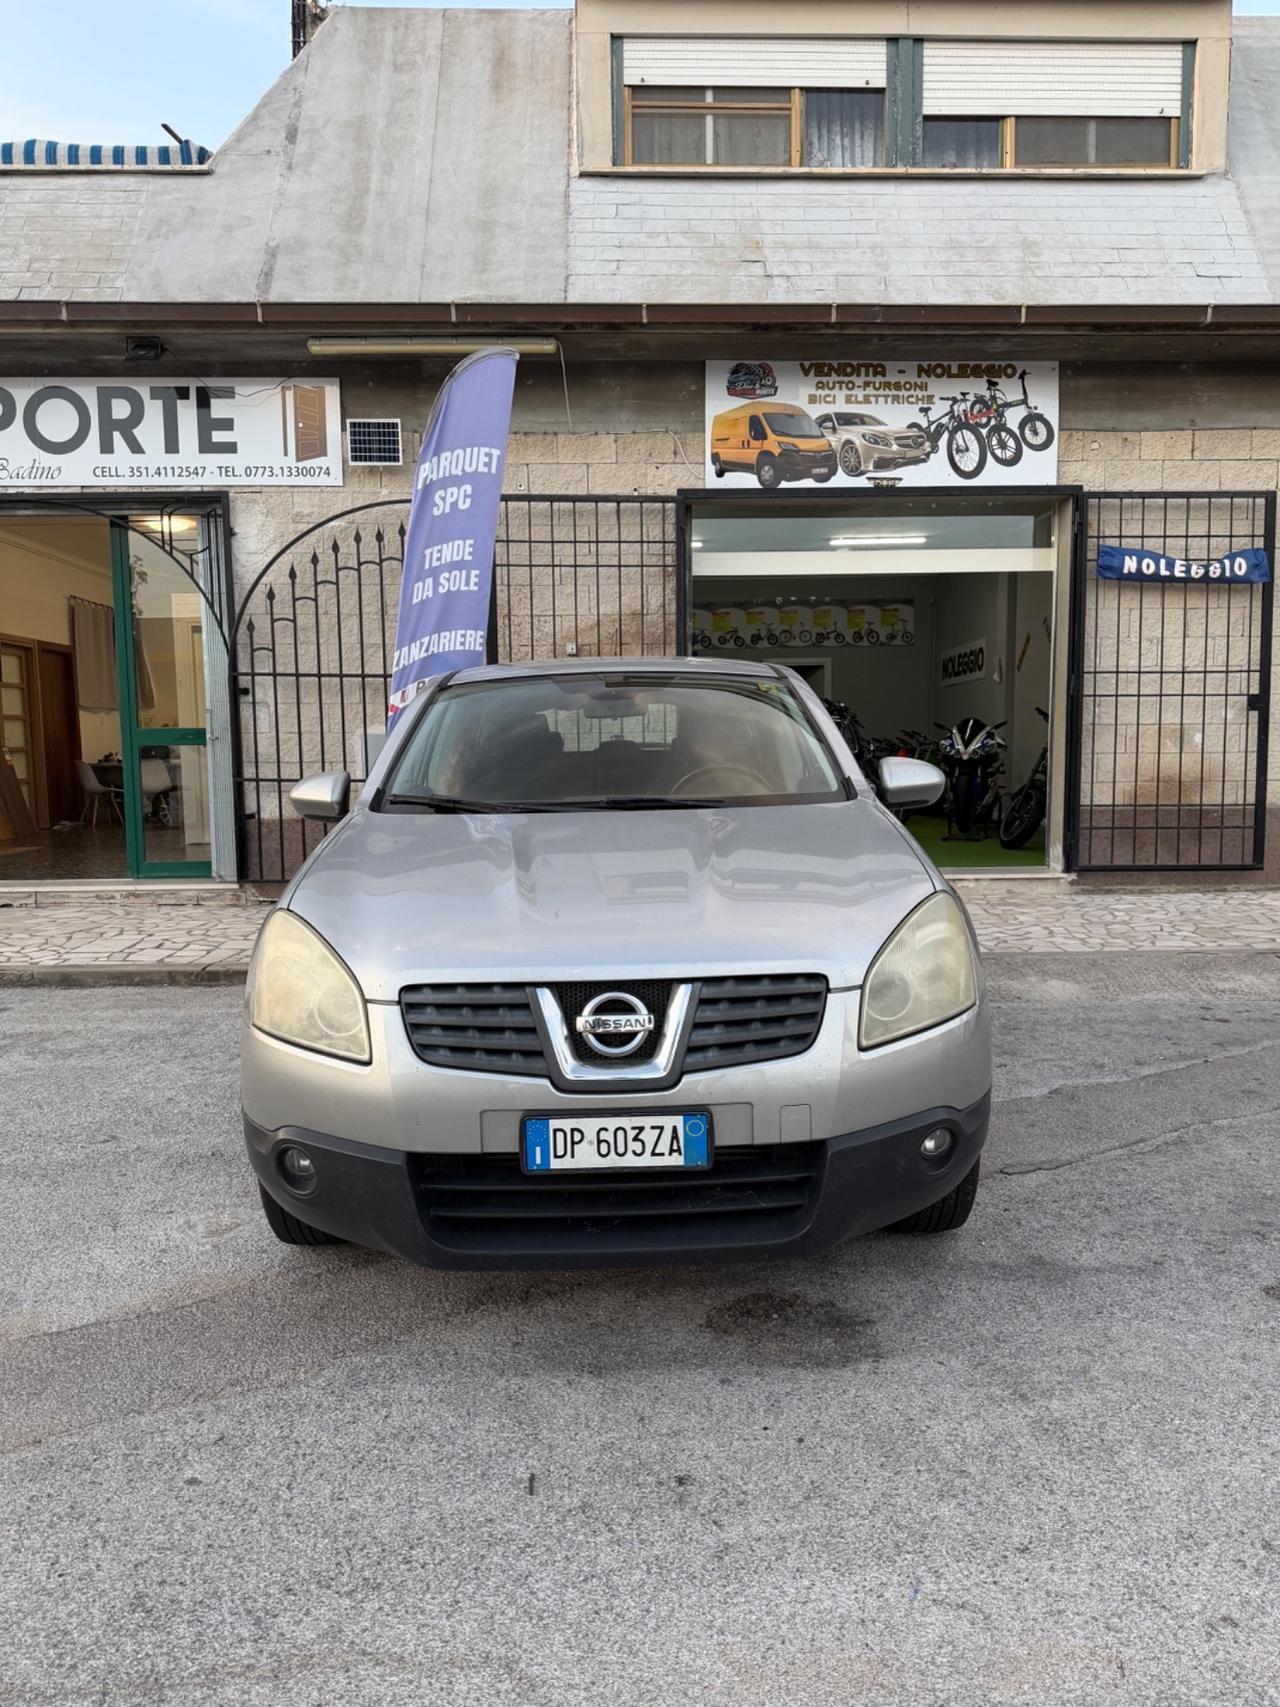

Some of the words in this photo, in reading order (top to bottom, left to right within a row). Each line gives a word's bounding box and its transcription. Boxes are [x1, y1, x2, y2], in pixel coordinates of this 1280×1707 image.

[799, 362, 887, 378] VENDITA
[916, 362, 1018, 379] NOLEGGIO
[815, 381, 929, 392] AUTO-FURGONI
[808, 394, 837, 405] BICI
[844, 394, 936, 405] ELETTRICHE
[93, 466, 126, 478] CELL.
[128, 466, 207, 478] 351.4112547
[217, 466, 242, 478] TEL.
[244, 466, 331, 478] 0773.1330074
[417, 447, 501, 490] PARQUET
[432, 484, 473, 517] SPC
[424, 539, 475, 571] TENDE
[1122, 555, 1248, 579] NOLEGGIO
[411, 582, 434, 605] DA
[438, 570, 481, 594] SOLE
[392, 629, 485, 672] ZANZARIERE
[942, 646, 986, 680] NOLEGGIO
[585, 1017, 646, 1029] NISSAN
[552, 1127, 585, 1160] DP
[596, 1125, 683, 1158] 603ZA
